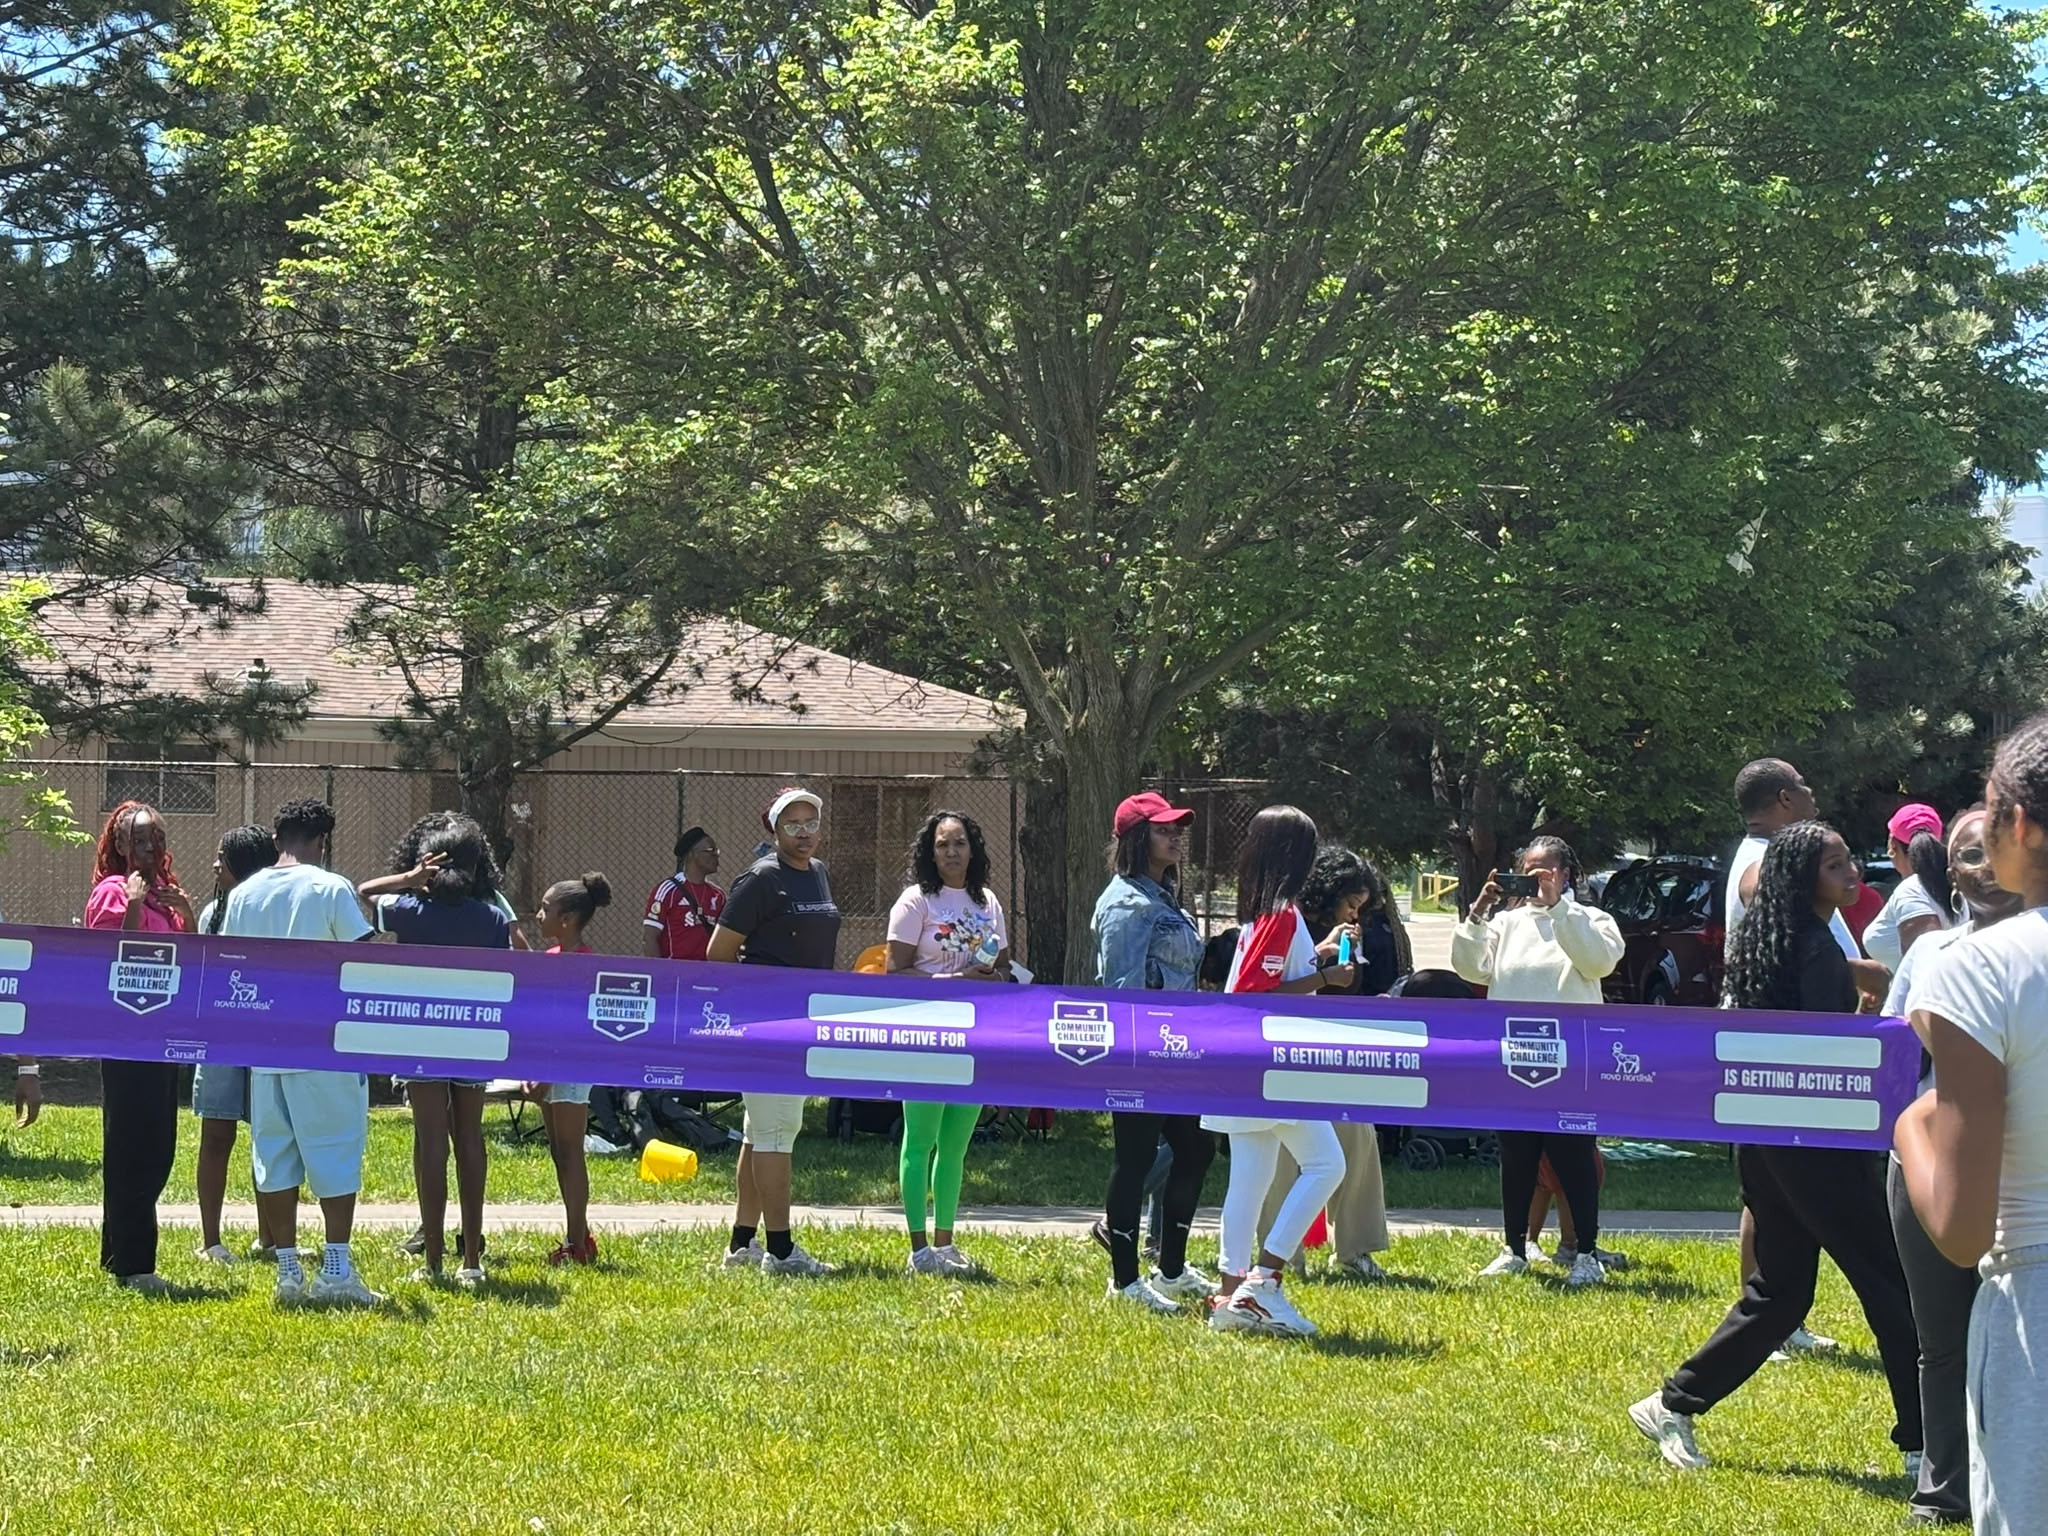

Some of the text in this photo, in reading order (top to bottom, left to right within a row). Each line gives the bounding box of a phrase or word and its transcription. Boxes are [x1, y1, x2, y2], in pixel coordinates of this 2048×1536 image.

[117, 965, 174, 980] COMMUNITY
[0, 977, 18, 995] OR
[117, 977, 170, 991] CHALLENGE
[595, 997, 649, 1010] COMMUNITY
[346, 998, 502, 1023] IS GETTING ACTIVE FOR
[596, 1008, 646, 1020] CHALLENGE
[1055, 1022, 1107, 1033] COMMUNITY
[816, 1025, 966, 1048] IS GETTING ACTIVE FOR
[1057, 1032, 1106, 1043] CHALLENGE
[1508, 1040, 1560, 1052] COMMUNITY
[165, 1047, 206, 1060] Canada
[1273, 1046, 1420, 1070] IS GETTING ACTIVE FOR
[1510, 1051, 1559, 1064] CHALLENGE
[643, 1073, 684, 1086] Canada
[1724, 1068, 1872, 1093] IS GETTING ACTIVE FOR
[1105, 1097, 1145, 1109] Canada
[1558, 1120, 1597, 1131] Canada
